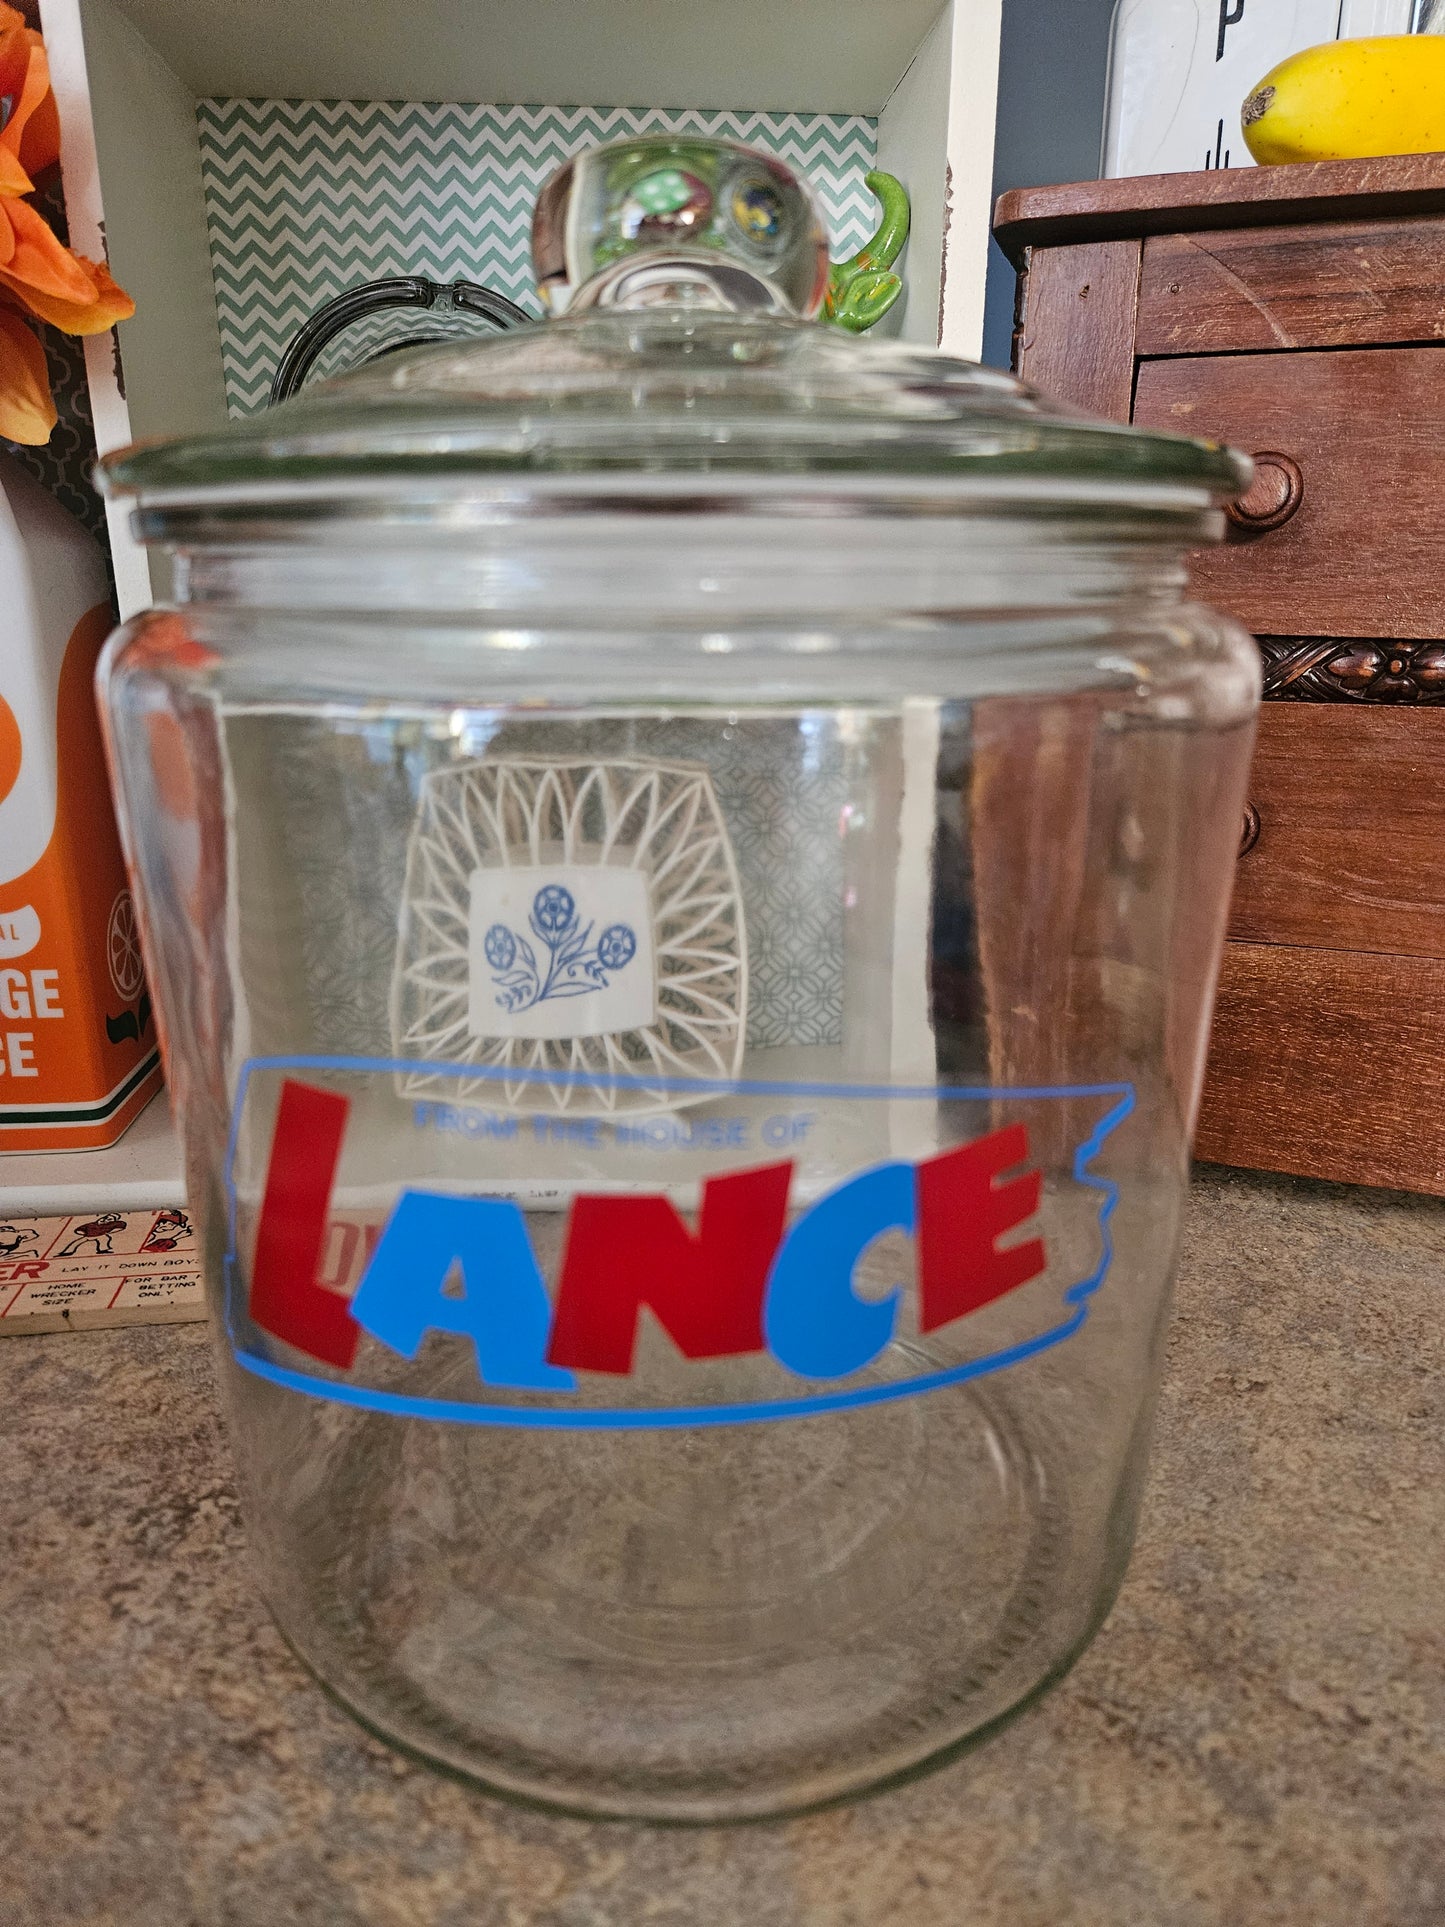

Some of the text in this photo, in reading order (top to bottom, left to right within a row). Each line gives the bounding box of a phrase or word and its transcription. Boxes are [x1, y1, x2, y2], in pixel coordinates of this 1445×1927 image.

[412, 1101, 818, 1152] FROM THE HOUSE OF
[247, 1077, 1050, 1393] LANCE
[61, 1265, 89, 1273] LAY
[119, 1261, 158, 1269] DOWN
[124, 1276, 152, 1284] FOR
[48, 1282, 86, 1291] HOME
[138, 1281, 196, 1291] BETTING
[30, 1288, 97, 1299] WRECKER
[138, 1289, 174, 1298] ONLY
[41, 1297, 74, 1306] SIZE
